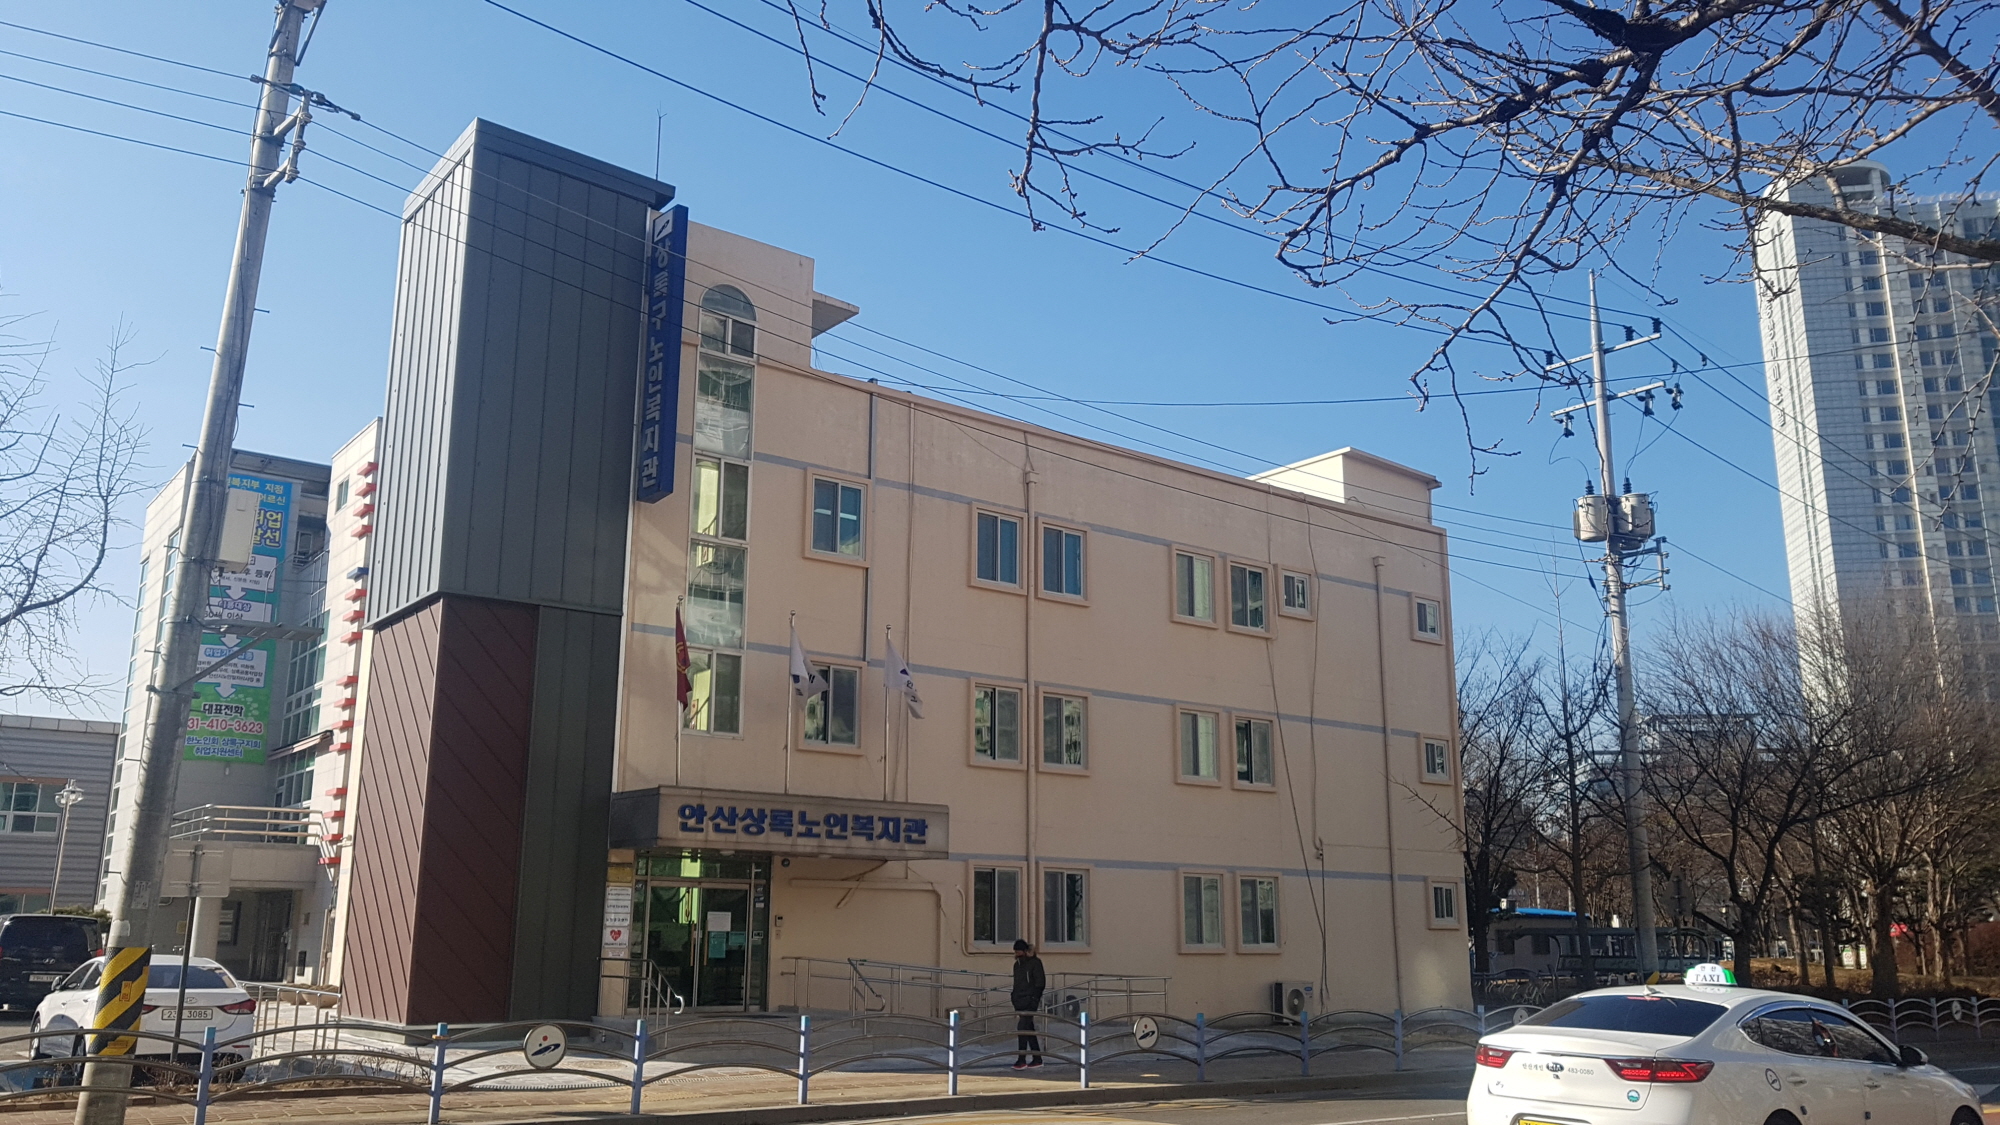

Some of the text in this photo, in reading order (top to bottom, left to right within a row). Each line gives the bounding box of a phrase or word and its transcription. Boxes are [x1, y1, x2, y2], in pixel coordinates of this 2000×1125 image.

[265, 483, 284, 494] 지정
[260, 493, 286, 505] 어르신
[203, 703, 244, 717] 대표전화
[187, 717, 263, 734] 31-410-3623
[222, 738, 261, 749] 상록구지회
[194, 746, 243, 758] 취업지원센터
[677, 803, 929, 845] 안산상록노인복지관
[1695, 974, 1721, 983] TAXI
[187, 1010, 208, 1019] 3085
[1547, 1062, 1563, 1072] KIA
